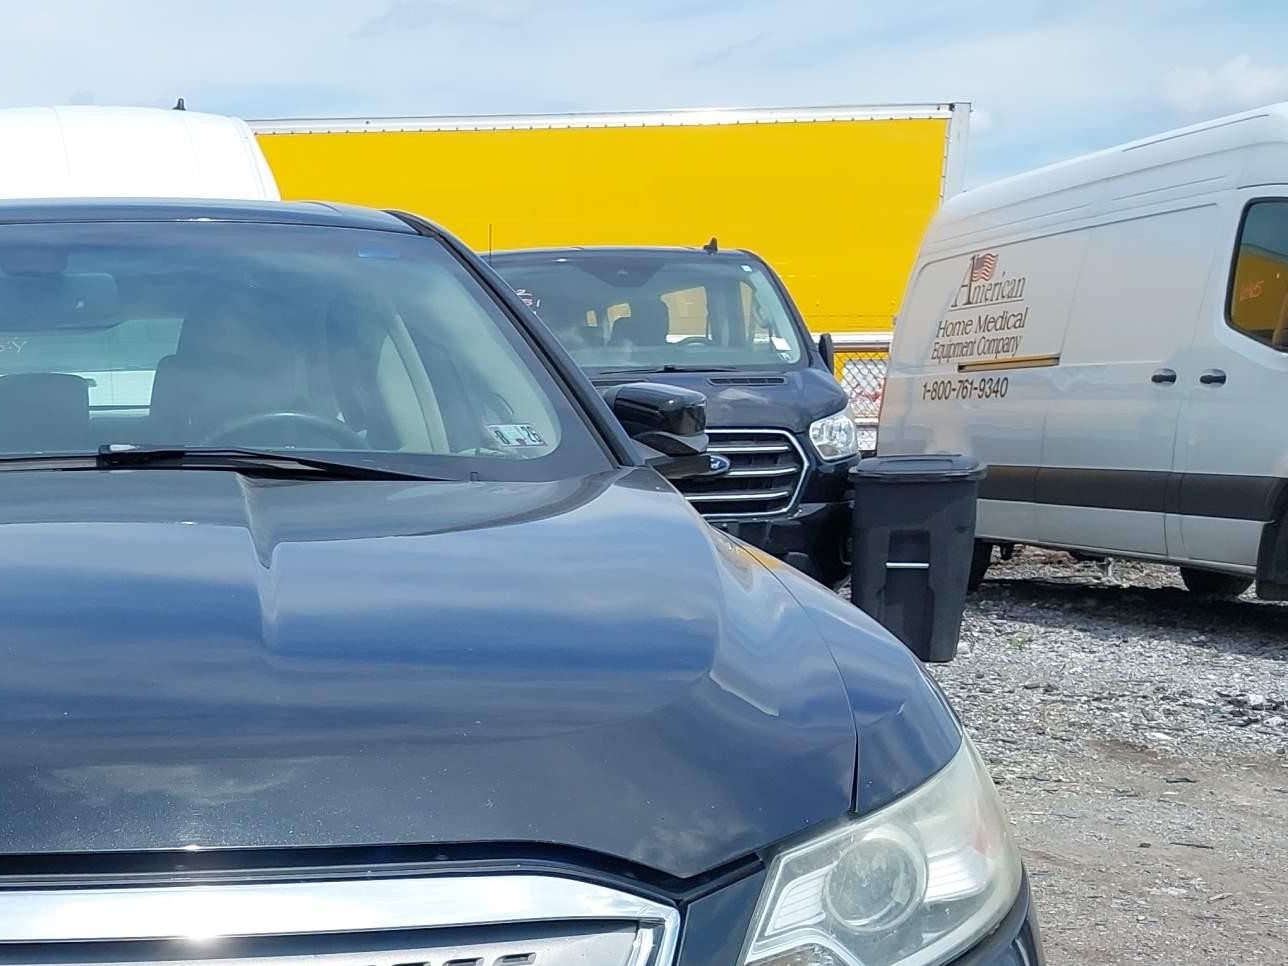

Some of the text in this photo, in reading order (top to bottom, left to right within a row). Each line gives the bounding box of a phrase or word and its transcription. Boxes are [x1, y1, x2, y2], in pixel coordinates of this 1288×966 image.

[950, 254, 1026, 308] American
[935, 307, 1029, 339] Home Medical
[931, 335, 1022, 364] Equipment Company
[922, 377, 1009, 400] 1-800-761-9340
